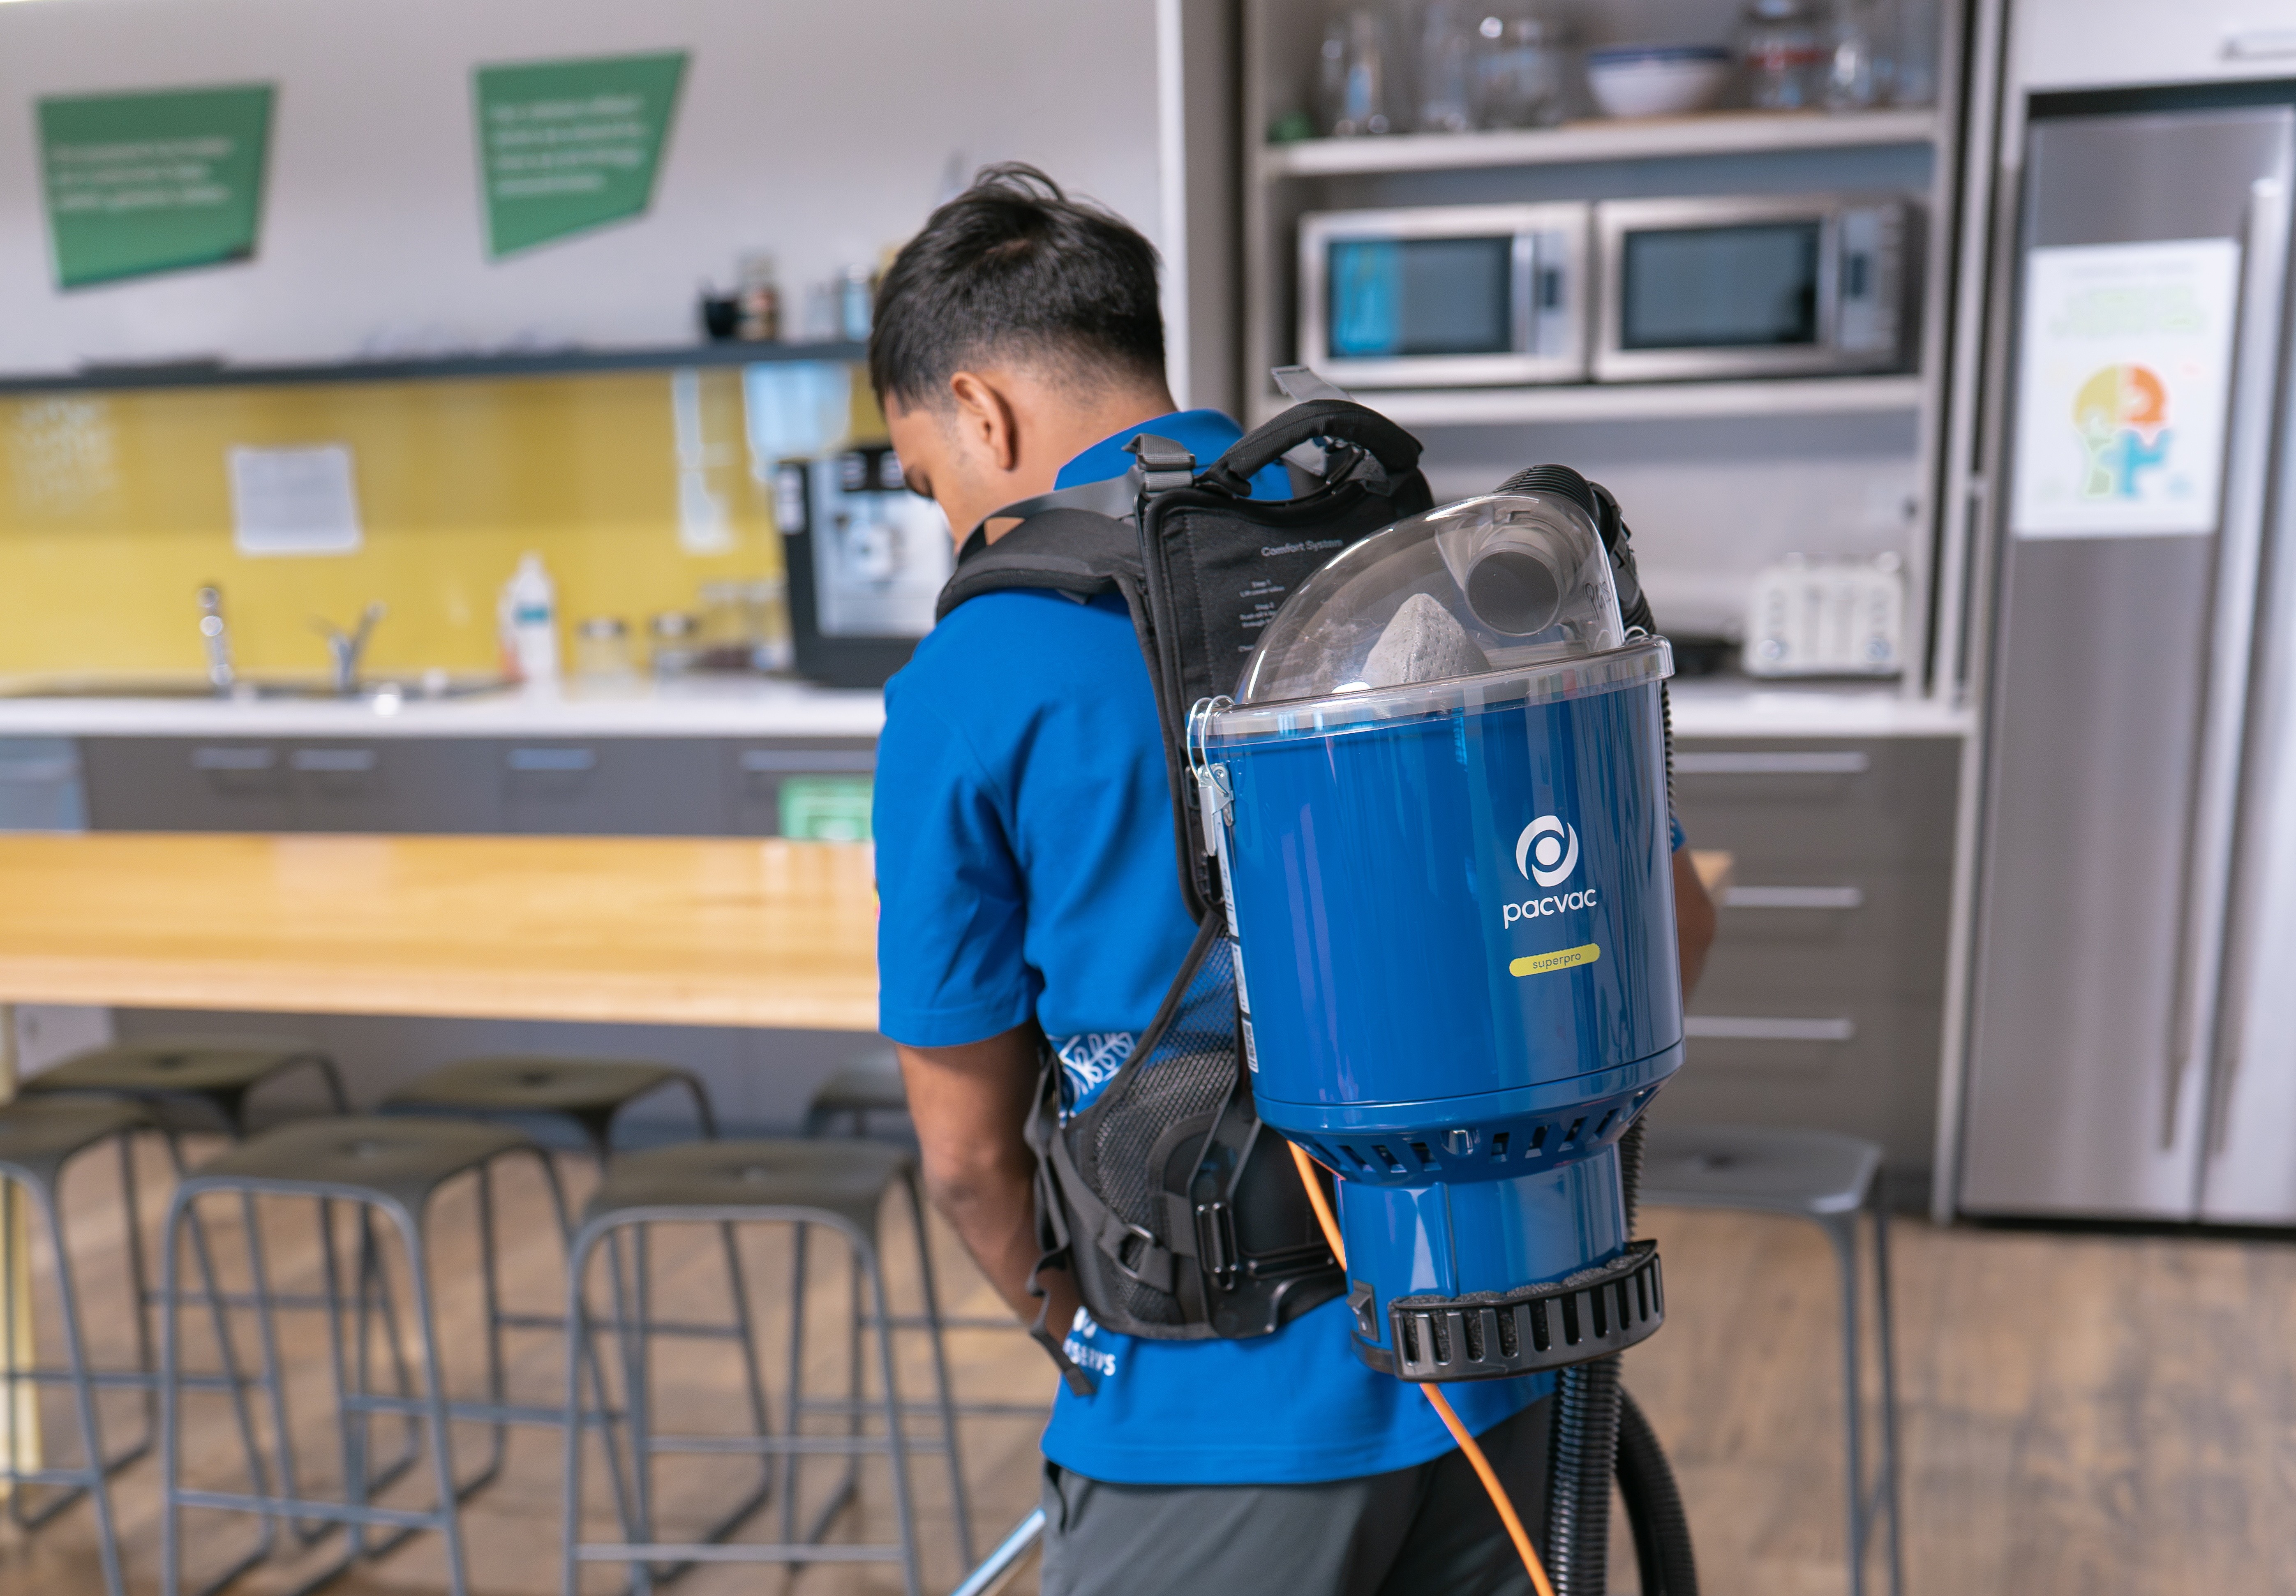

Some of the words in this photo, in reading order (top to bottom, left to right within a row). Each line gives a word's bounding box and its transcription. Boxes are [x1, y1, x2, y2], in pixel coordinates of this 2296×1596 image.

[1261, 542, 1305, 557] Comfort
[1305, 539, 1343, 552] System
[1503, 889, 1597, 929] pacvac
[1533, 952, 1581, 969] superpro
